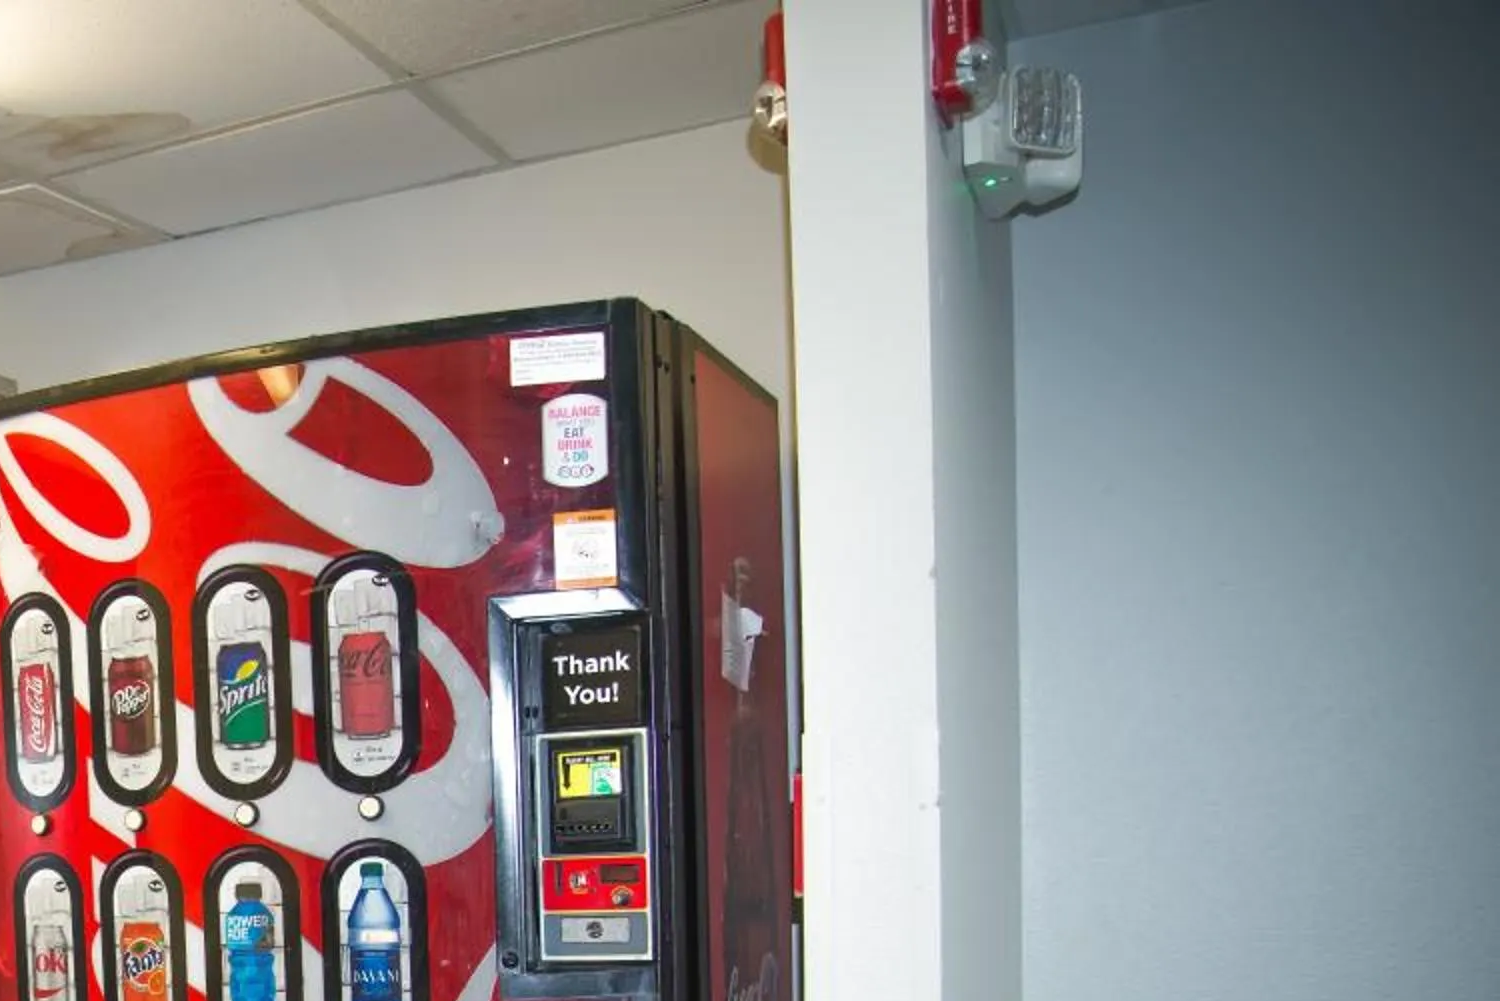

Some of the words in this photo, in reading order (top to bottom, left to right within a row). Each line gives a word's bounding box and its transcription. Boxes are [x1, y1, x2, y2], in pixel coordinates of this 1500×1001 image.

[947, 0, 957, 35] IRE
[563, 427, 584, 438] EAT
[552, 650, 631, 677] Thank
[563, 681, 620, 705] You!
